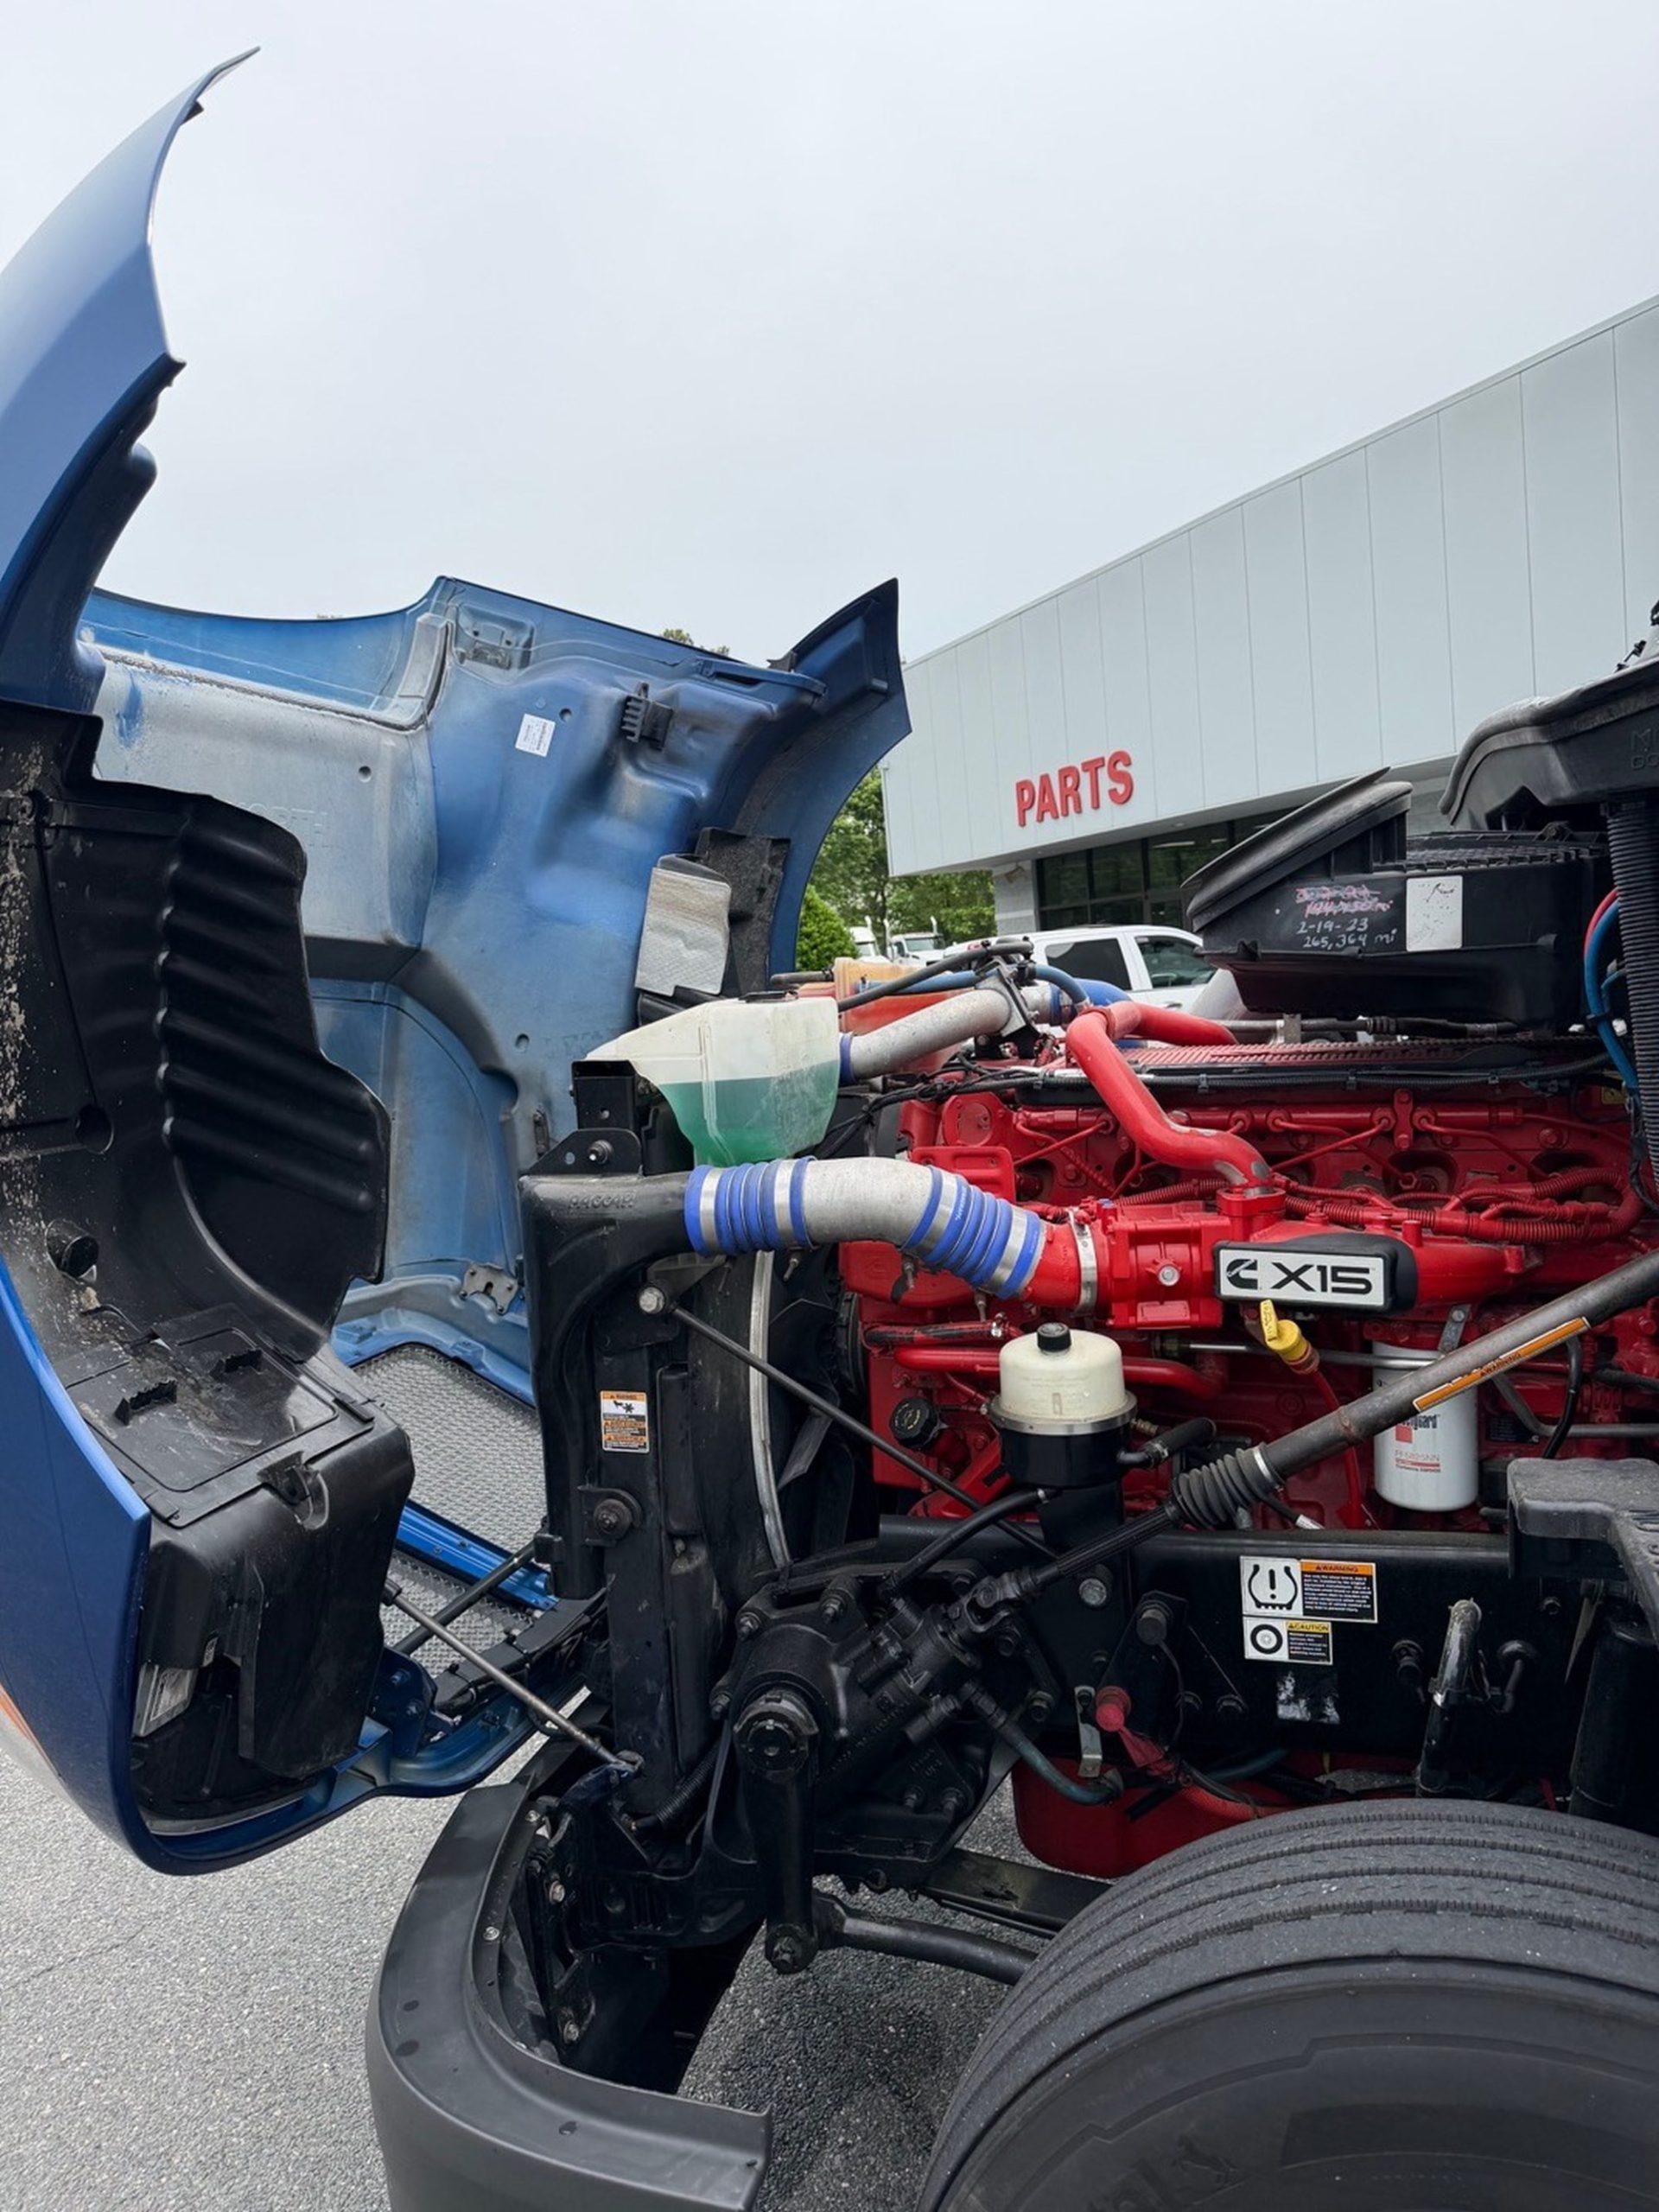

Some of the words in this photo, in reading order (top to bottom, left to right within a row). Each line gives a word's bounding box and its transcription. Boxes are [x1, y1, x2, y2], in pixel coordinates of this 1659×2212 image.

[1015, 750, 1135, 827] PARTS
[1374, 928, 1398, 944] mi
[1270, 1261, 1373, 1295] X15
